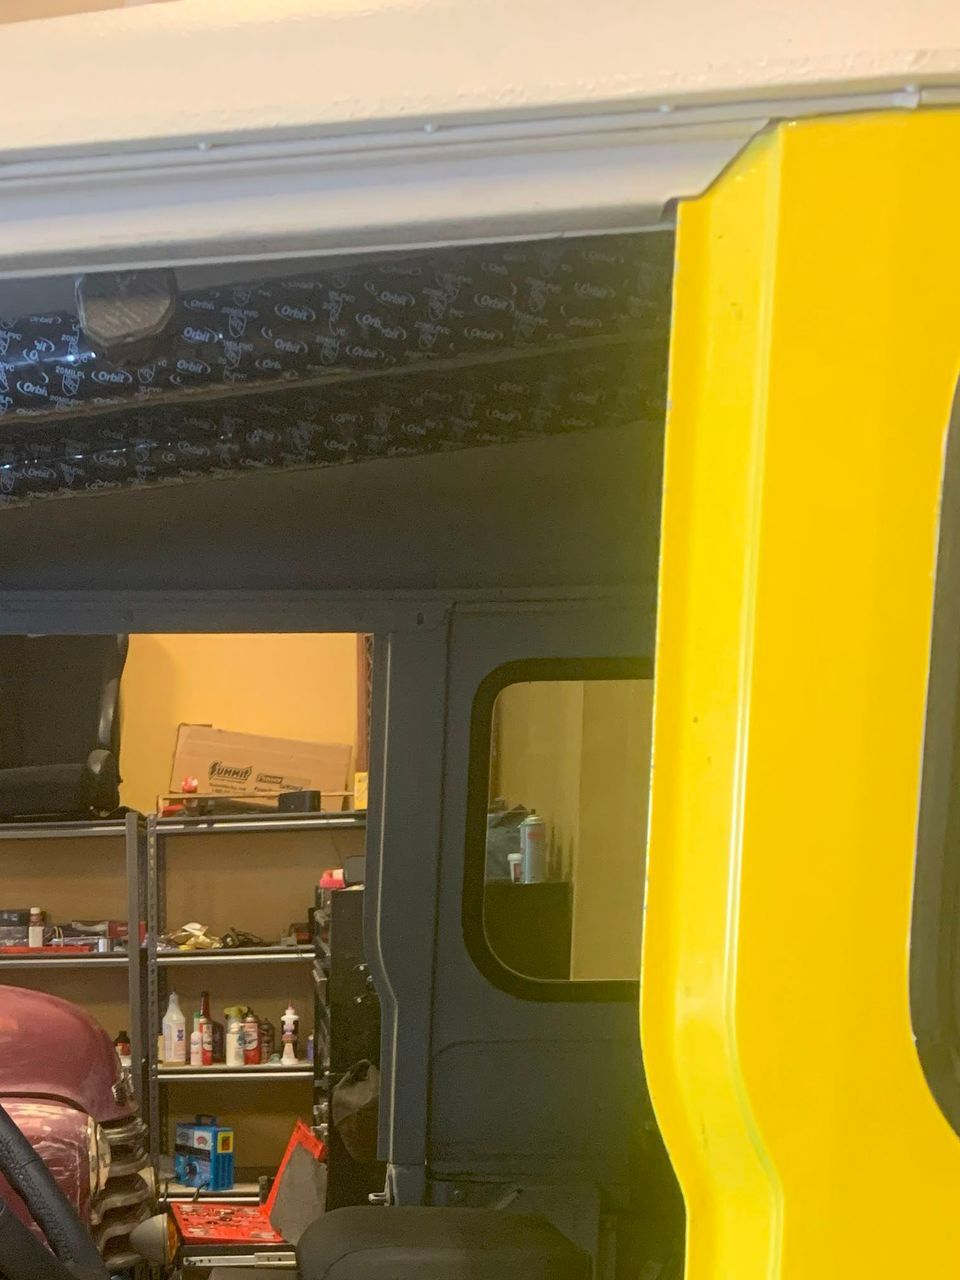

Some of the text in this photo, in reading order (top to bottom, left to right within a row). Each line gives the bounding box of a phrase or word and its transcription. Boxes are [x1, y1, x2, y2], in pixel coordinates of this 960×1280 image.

[380, 292, 408, 305] Orbit
[480, 297, 508, 309] Orbit
[281, 306, 307, 320] Orbit
[183, 327, 210, 342] Orbit
[275, 339, 300, 352] Orbit
[352, 347, 377, 358] Orbit
[177, 360, 203, 372] Orbit
[99, 372, 125, 383] Orbit
